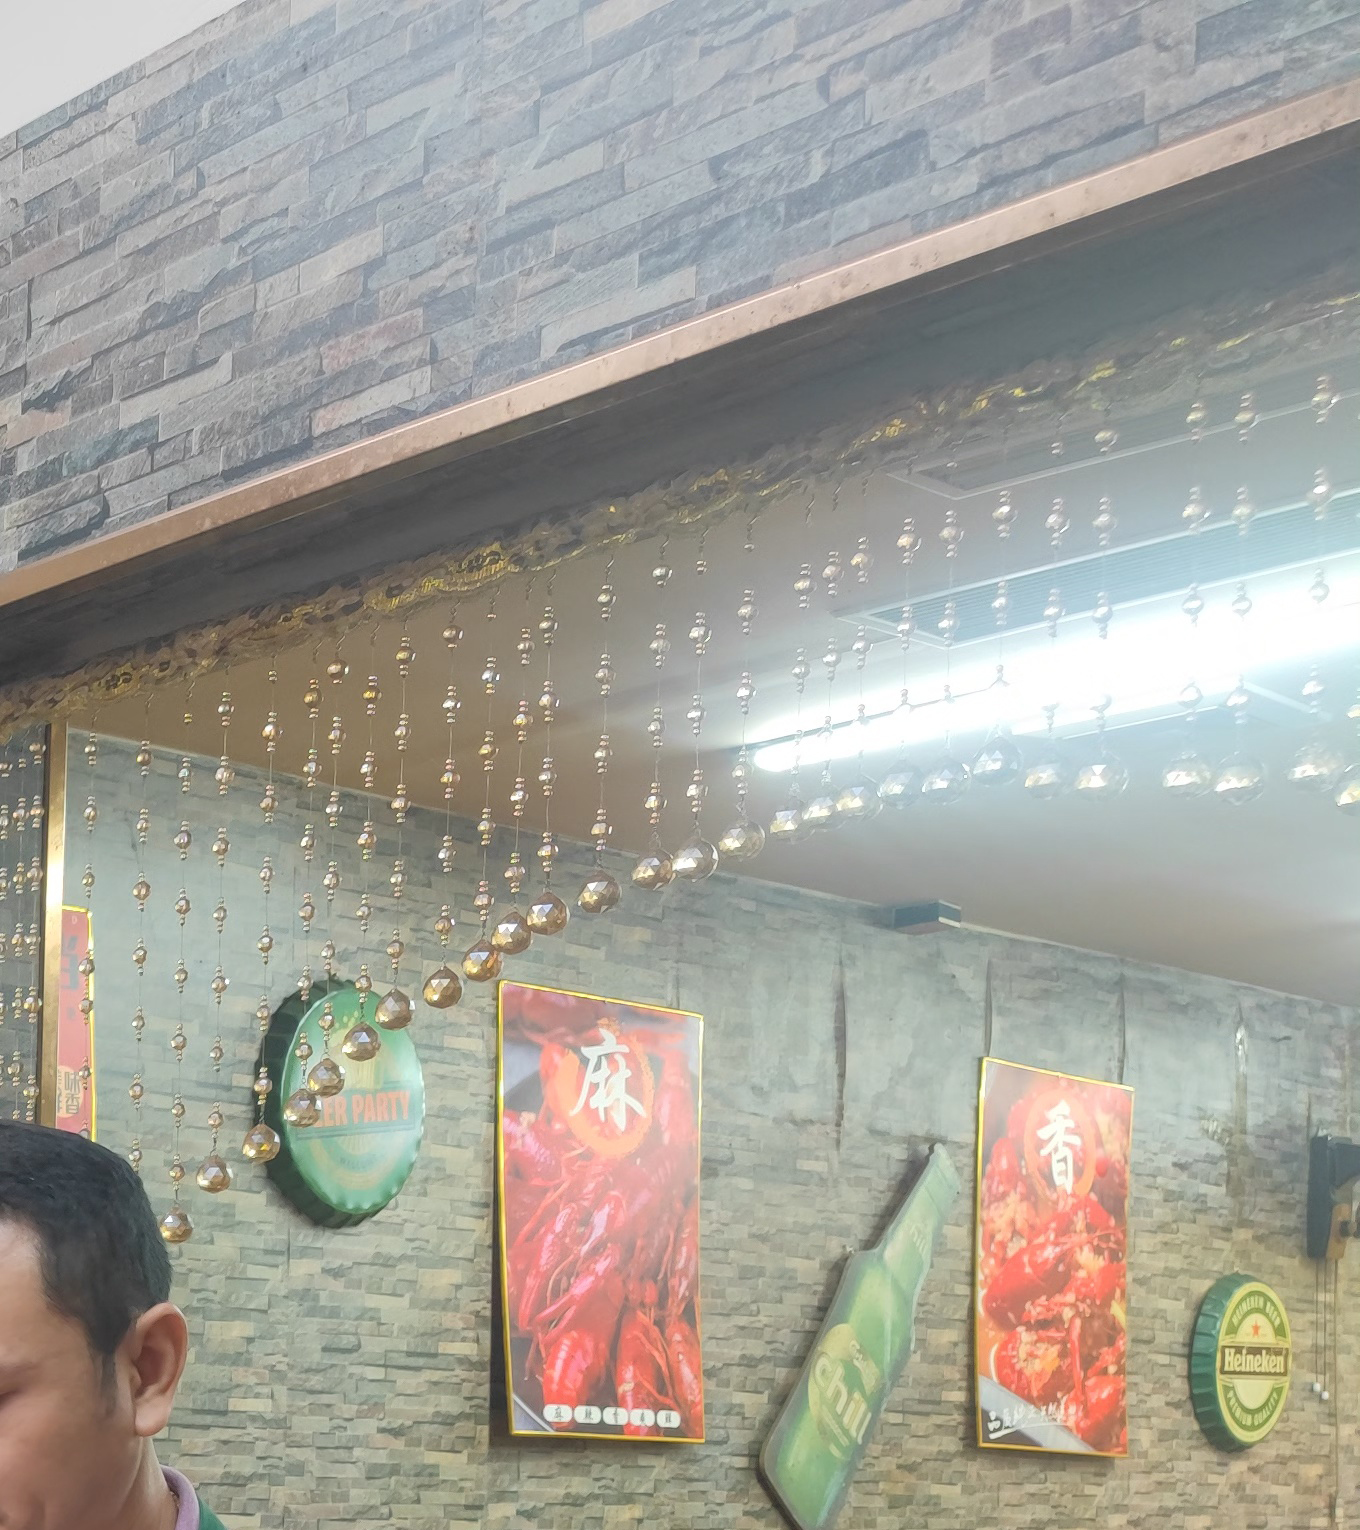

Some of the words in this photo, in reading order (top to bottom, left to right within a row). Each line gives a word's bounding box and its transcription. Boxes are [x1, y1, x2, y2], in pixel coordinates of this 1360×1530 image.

[351, 1090, 411, 1125] PARTY
[569, 1028, 647, 1132] 麻
[1036, 1099, 1082, 1195] 香
[1224, 1348, 1285, 1373] Heineken
